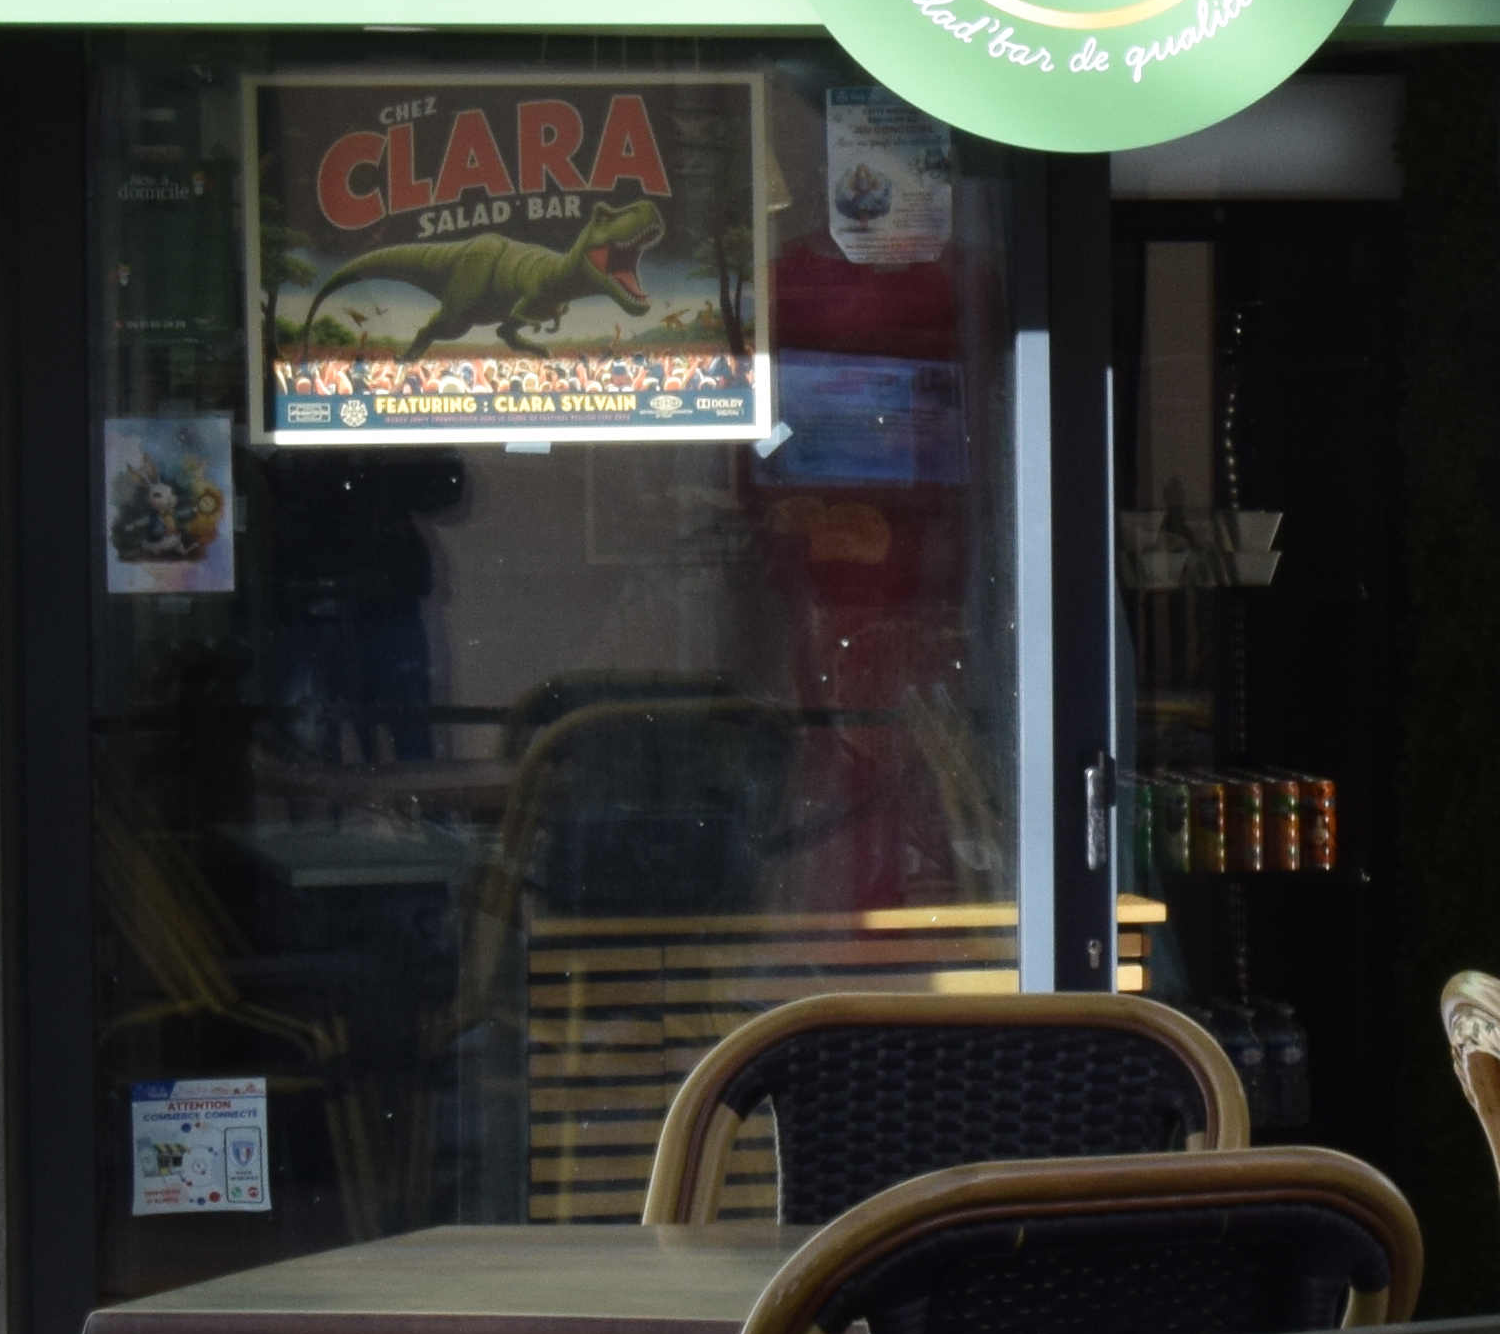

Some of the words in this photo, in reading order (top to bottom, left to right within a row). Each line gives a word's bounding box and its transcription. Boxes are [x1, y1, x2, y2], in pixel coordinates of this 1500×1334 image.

[1069, 37, 1110, 73] de
[379, 95, 438, 125] CHEZ
[317, 93, 672, 230] CLARA
[118, 182, 190, 200] domicile
[527, 194, 582, 221] BAR
[375, 394, 477, 414] FEATURING
[494, 394, 556, 413] CLARA
[560, 393, 637, 412] SYLVAIN
[711, 398, 744, 410] DOLBY
[168, 1100, 231, 1111] ATTENTION
